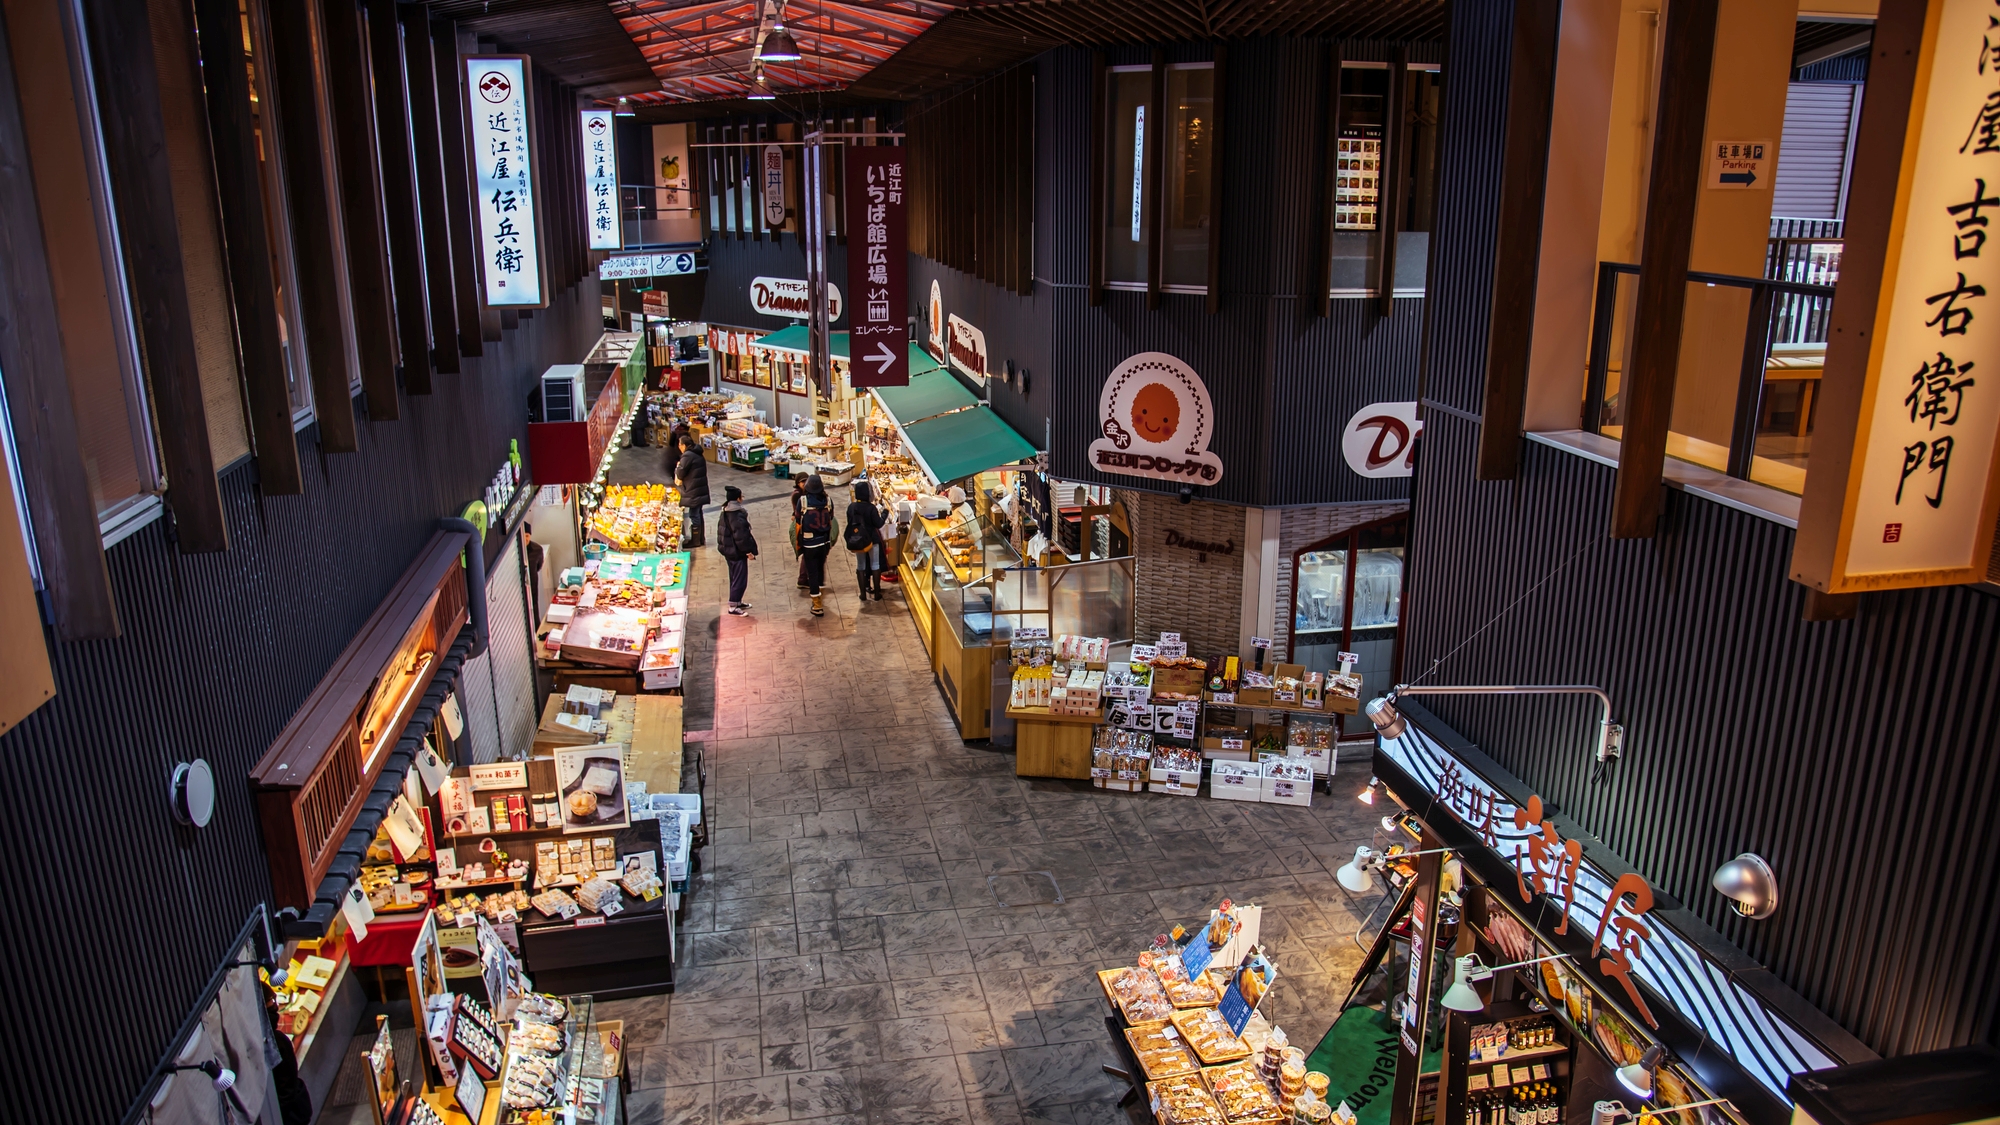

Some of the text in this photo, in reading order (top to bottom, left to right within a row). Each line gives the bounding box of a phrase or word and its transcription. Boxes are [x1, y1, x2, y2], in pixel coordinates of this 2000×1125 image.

[1718, 144, 1752, 159] 駐車場
[1722, 160, 1757, 170] Parking
[488, 112, 524, 275] 近江屋伝兵衛
[593, 139, 612, 232] 近江屋伝兵衛
[888, 163, 902, 205] 近江町
[866, 165, 888, 285] いちば館広場
[855, 325, 902, 335] エレベーター
[1106, 421, 1128, 447] 金沢
[1162, 529, 1234, 555] Diamond
[1884, 524, 1900, 542] 吉
[495, 769, 521, 779] 和菓子
[1331, 1037, 1399, 1112] Welcom
